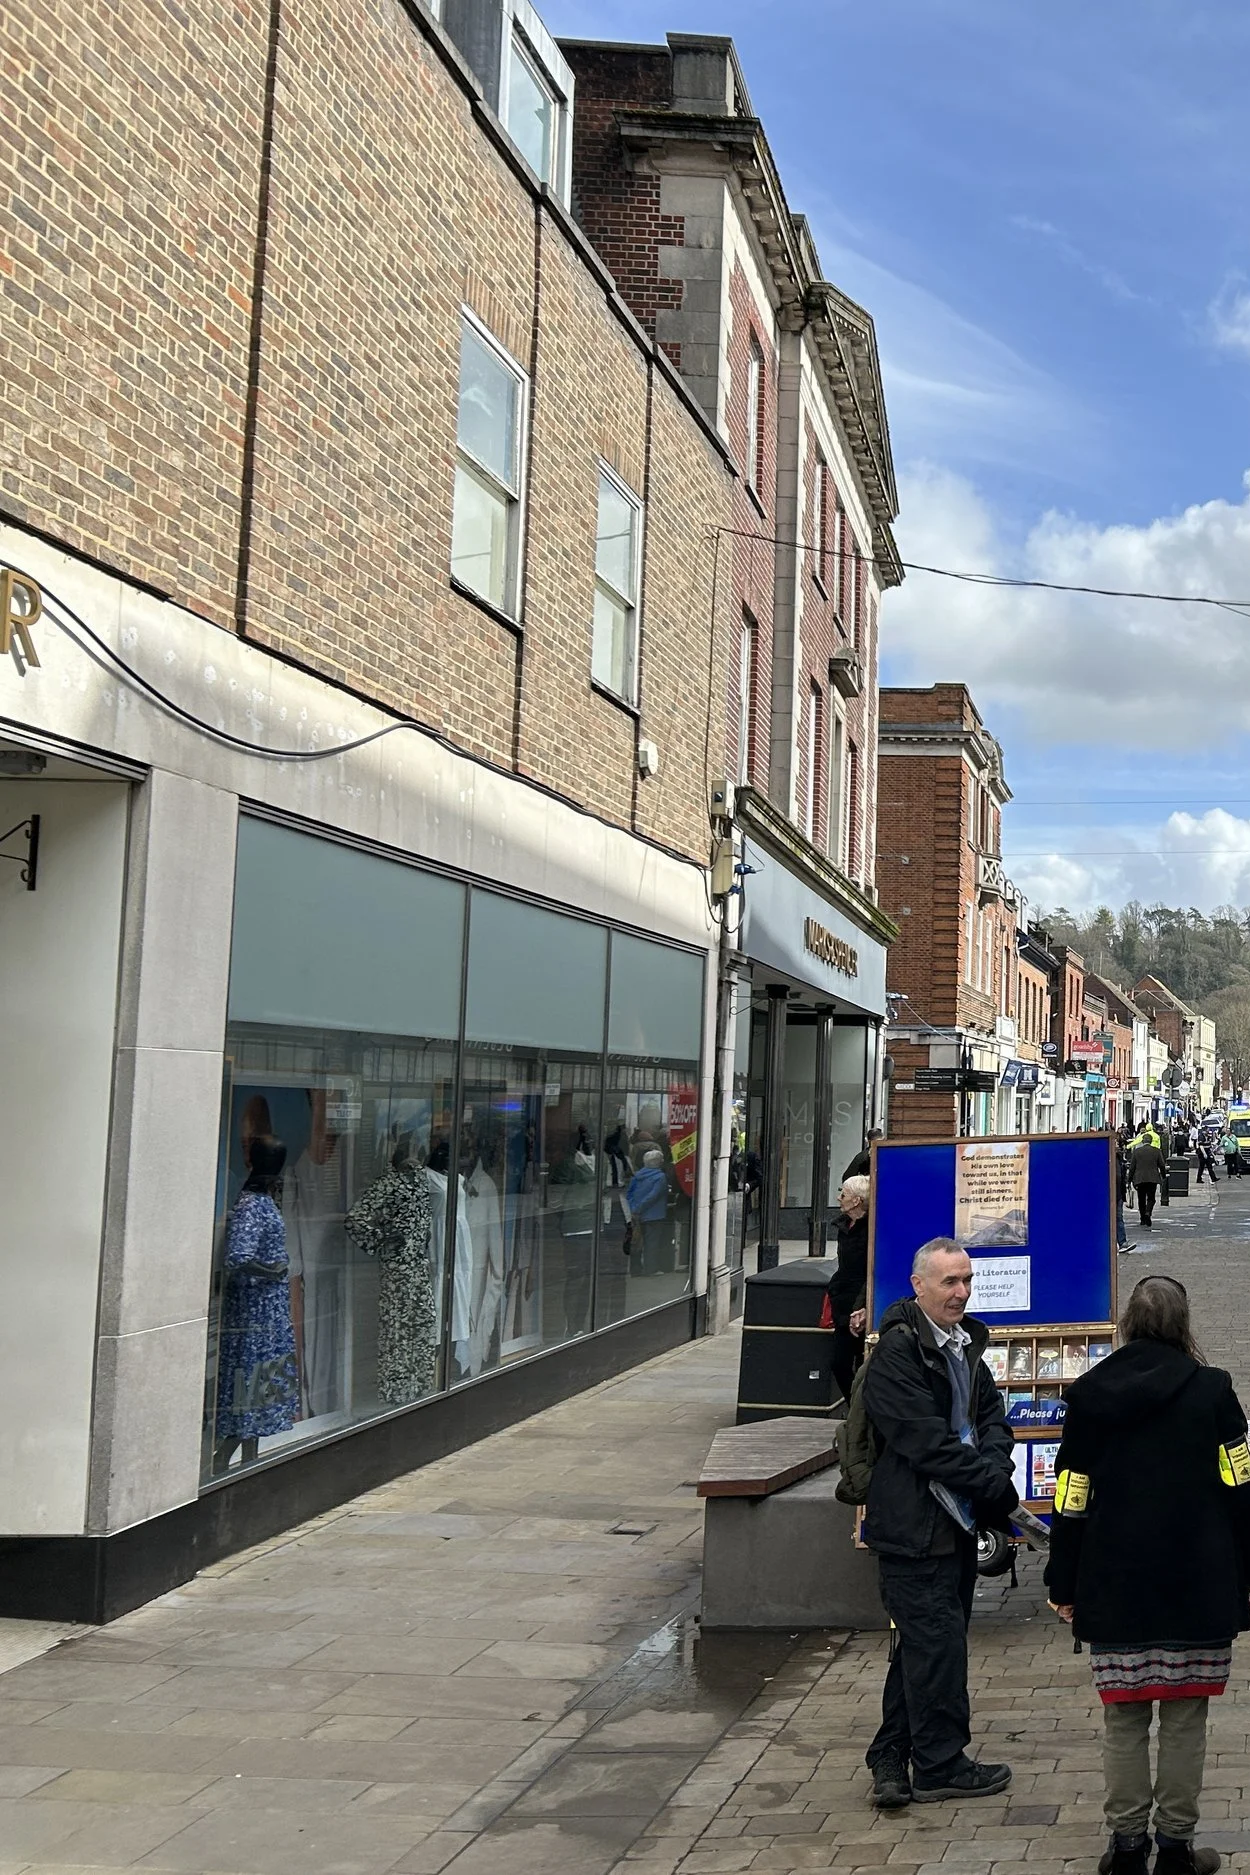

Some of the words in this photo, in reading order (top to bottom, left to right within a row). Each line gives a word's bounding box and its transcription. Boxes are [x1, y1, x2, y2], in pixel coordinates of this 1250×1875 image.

[784, 1101, 852, 1126] MS
[982, 1269, 1027, 1277] Literature
[1056, 1407, 1066, 1420] ju
